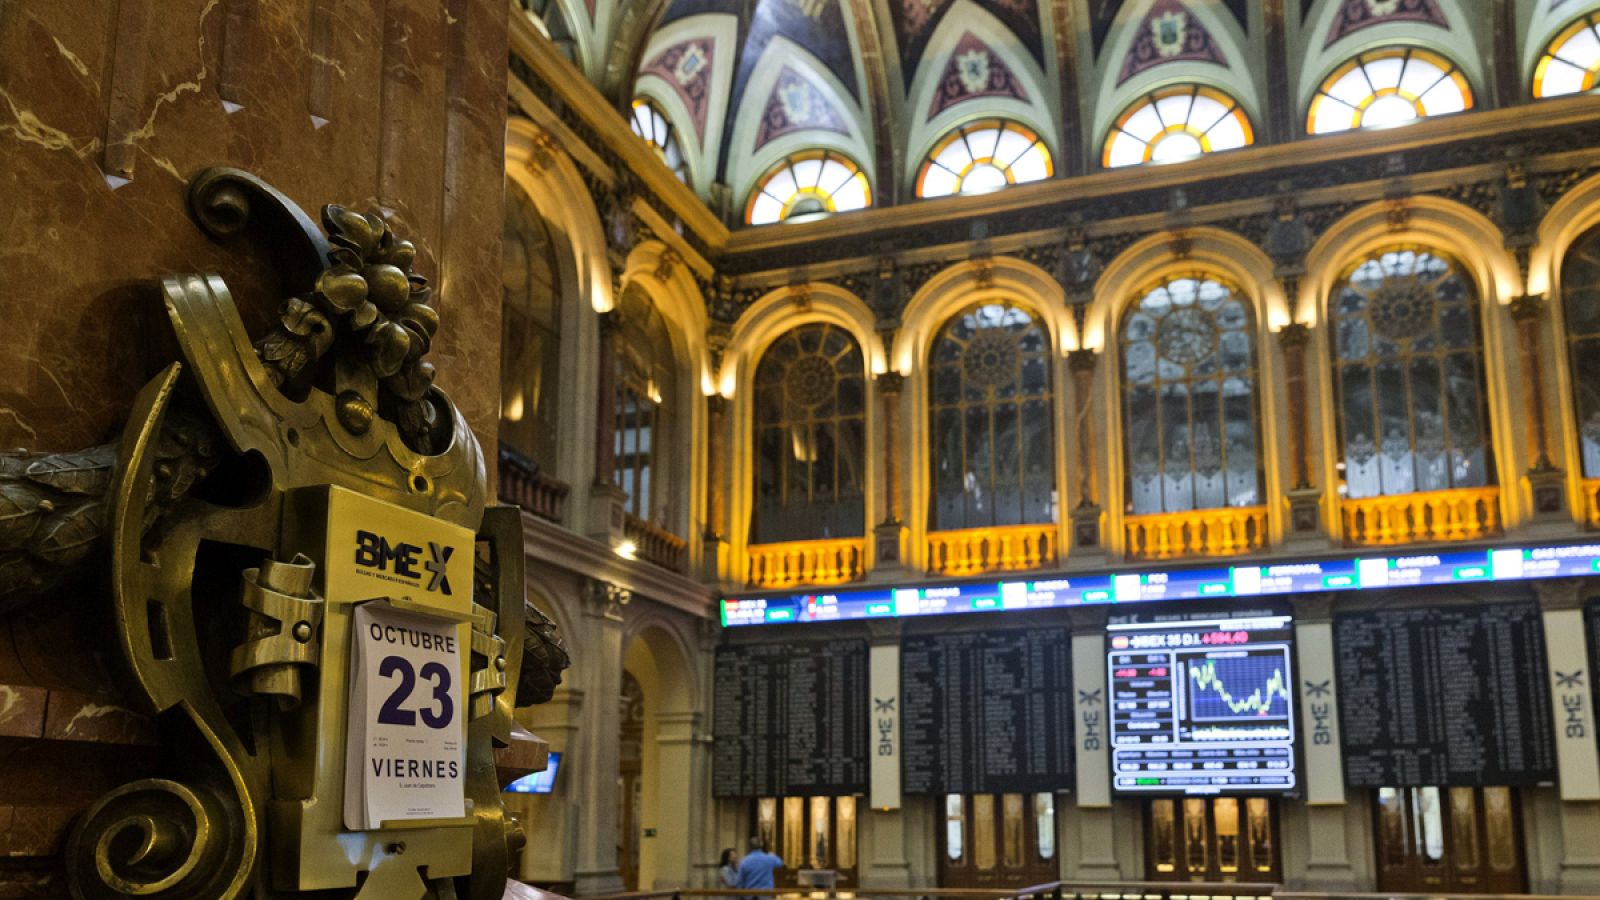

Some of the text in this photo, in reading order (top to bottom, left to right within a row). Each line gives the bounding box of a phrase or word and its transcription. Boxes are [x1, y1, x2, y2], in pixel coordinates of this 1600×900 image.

[356, 529, 423, 580] BME
[370, 623, 456, 653] OCTUBRE
[377, 655, 454, 729] 23
[1083, 711, 1100, 750] BME
[1311, 703, 1330, 745] BME
[1562, 694, 1584, 738] BME
[878, 718, 892, 756] BME
[371, 758, 458, 778] VIERNES
